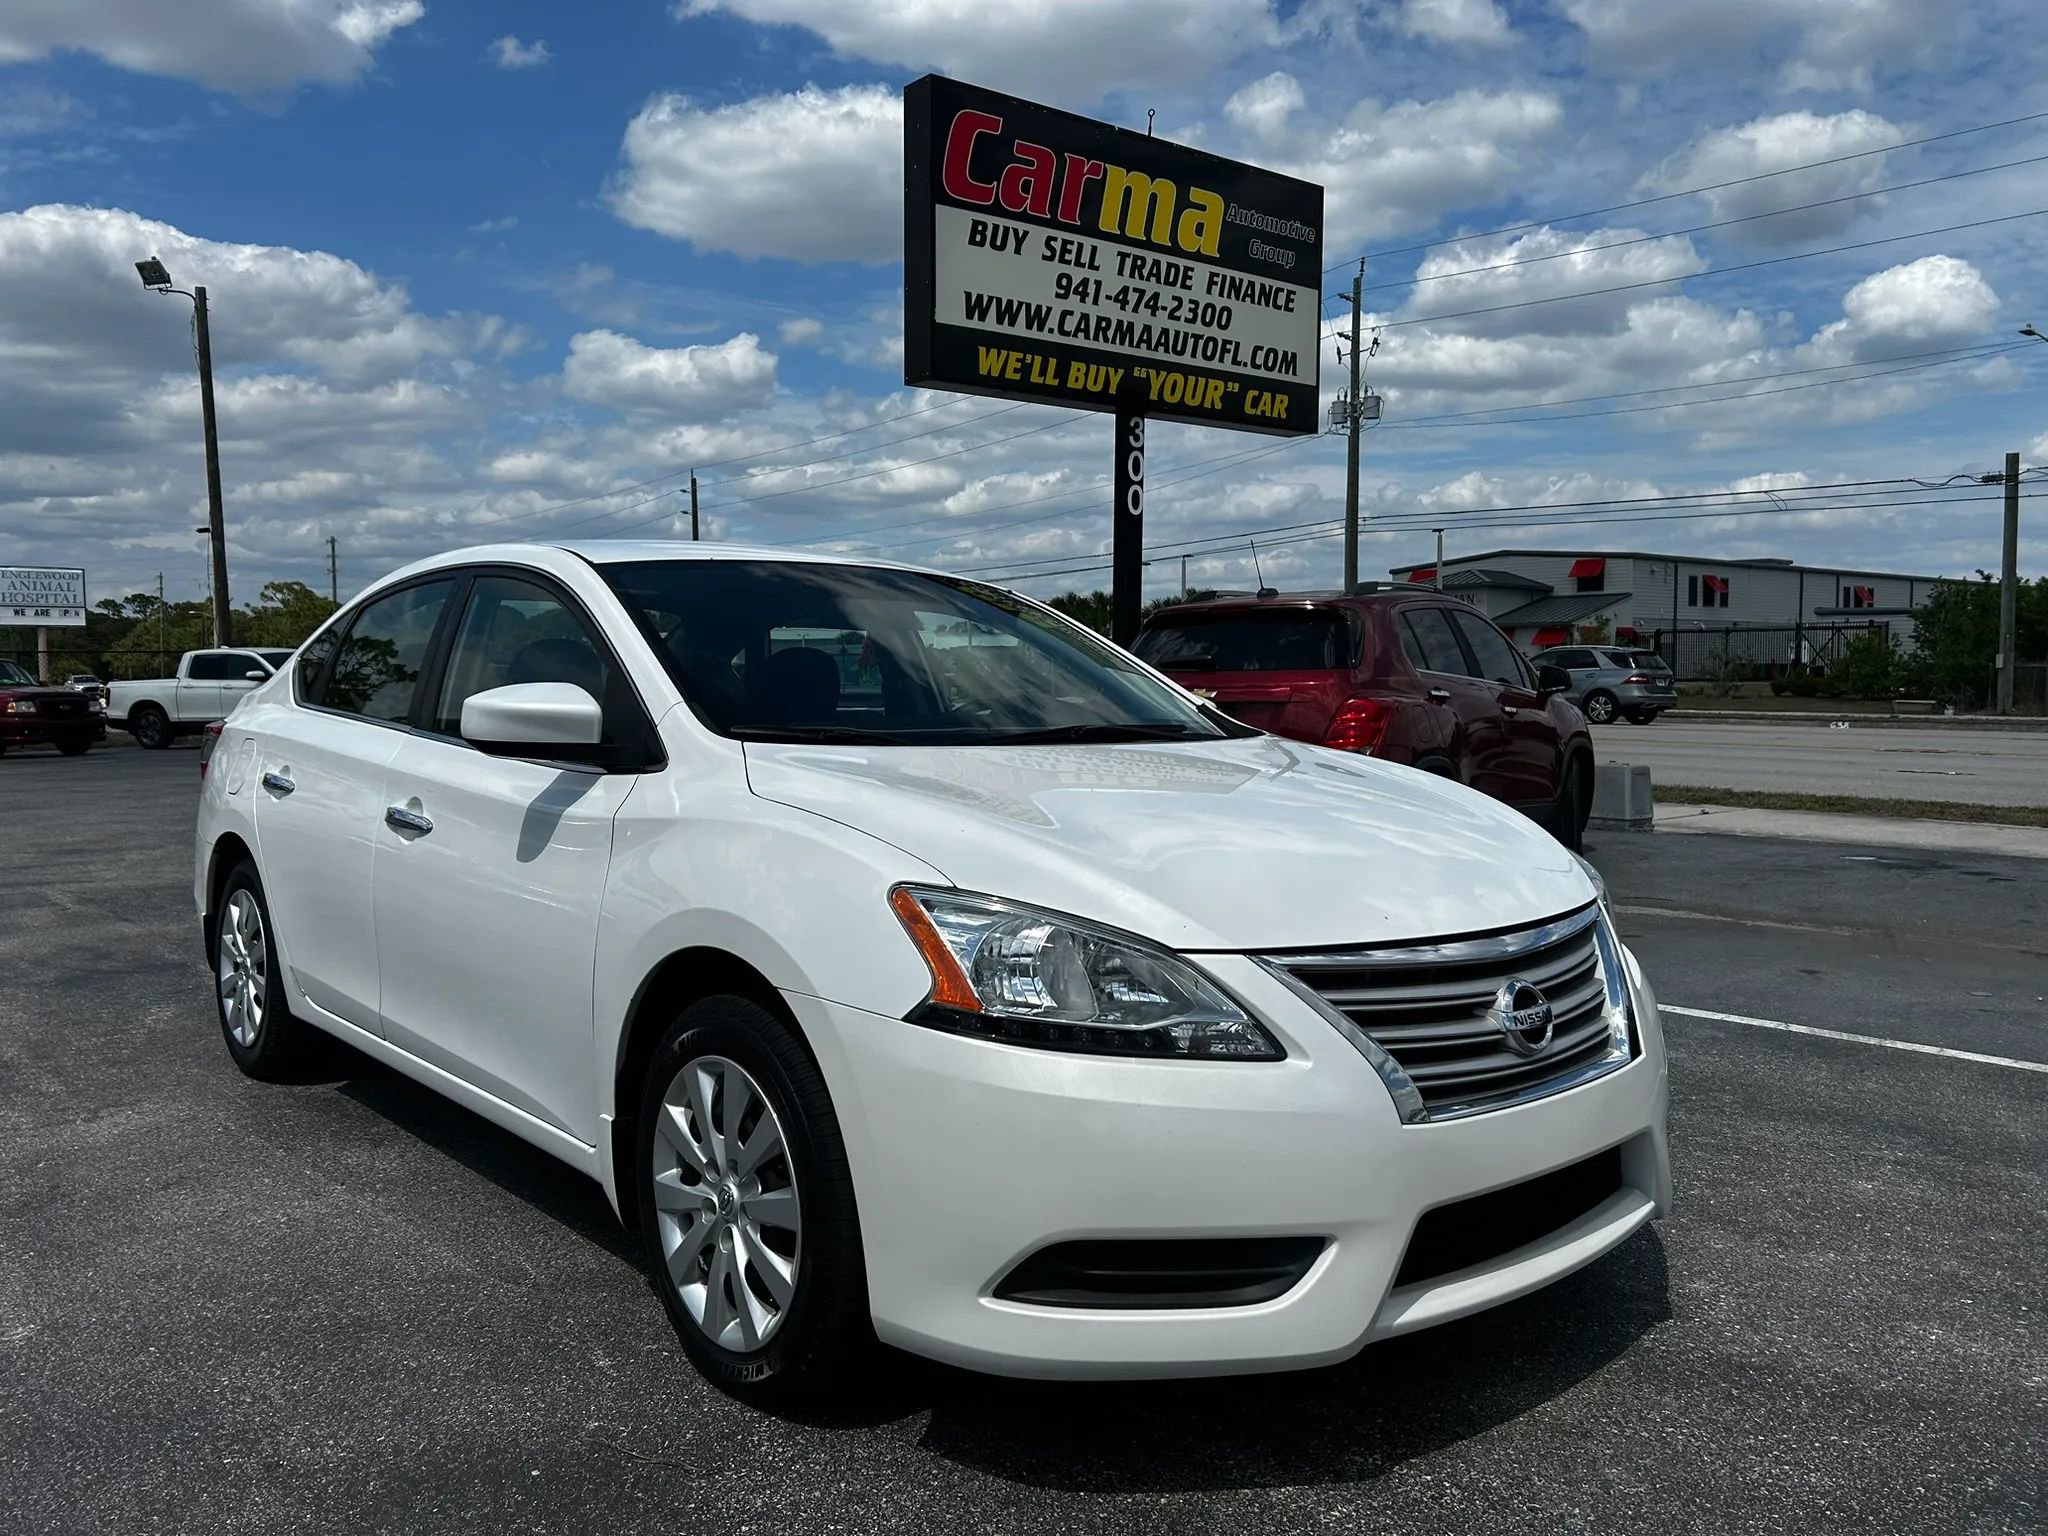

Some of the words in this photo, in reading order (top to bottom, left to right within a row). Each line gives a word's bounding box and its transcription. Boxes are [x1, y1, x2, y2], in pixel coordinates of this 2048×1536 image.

[943, 109, 1225, 258] Carma
[1226, 203, 1316, 243] Automotive
[967, 219, 1030, 256] BUY
[1041, 235, 1101, 272] SELL
[1116, 250, 1195, 291] TRADE
[1205, 270, 1297, 313] FINANCE
[1249, 238, 1296, 267] Group
[1055, 272, 1233, 331] 941-474-2300
[964, 291, 1298, 377] WWW.CARMAAUTOFL.COM
[978, 346, 1059, 386] WE'LL
[1067, 360, 1125, 394] BUY
[1244, 389, 1289, 419] CAR
[1128, 416, 1145, 515] 300
[1, 570, 80, 581] ENGLEWOOD
[7, 580, 76, 592] ANIMAL
[1, 592, 81, 604] HOSPITAL
[13, 608, 26, 616] WE
[34, 609, 51, 617] ARE
[1512, 1005, 1552, 1027] NISSA
